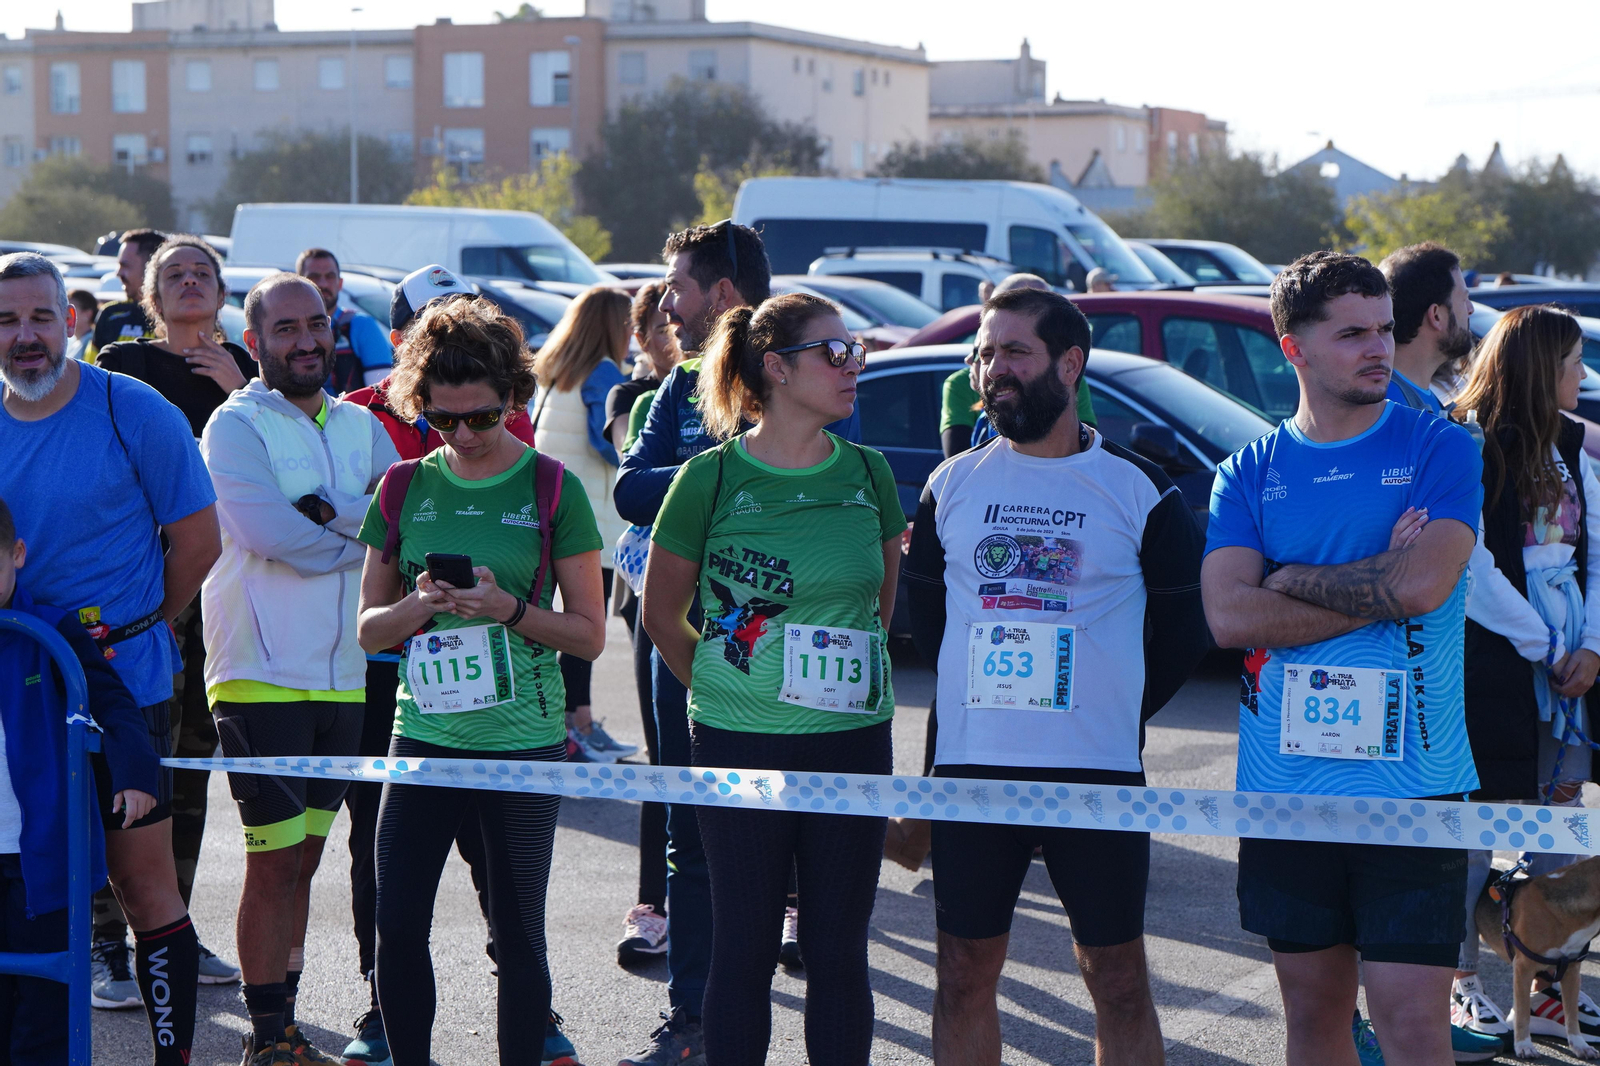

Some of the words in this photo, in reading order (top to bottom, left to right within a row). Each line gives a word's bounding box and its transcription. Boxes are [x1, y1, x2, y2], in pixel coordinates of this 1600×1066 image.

[1313, 472, 1355, 484] TEAMERGY
[984, 504, 1000, 524] II
[1000, 516, 1050, 526] NOCTURNA
[1003, 505, 1050, 514] CARRERA
[1052, 510, 1086, 529] CPT
[708, 552, 794, 598] PIRATA
[742, 548, 792, 575] TRAIL
[440, 640, 463, 648] PIRATA
[830, 639, 853, 647] PIRATA
[419, 655, 482, 685] 1115
[492, 630, 509, 698] CAMINATA
[799, 654, 862, 684] 1113
[867, 640, 879, 707] CAMINATA
[983, 651, 1034, 678] 653
[1056, 632, 1071, 706] PIRATILLA
[1328, 679, 1357, 687] PIRATA
[1304, 696, 1362, 726] 834
[1385, 677, 1400, 754] PIRATILLA
[148, 946, 175, 1047] WONG
